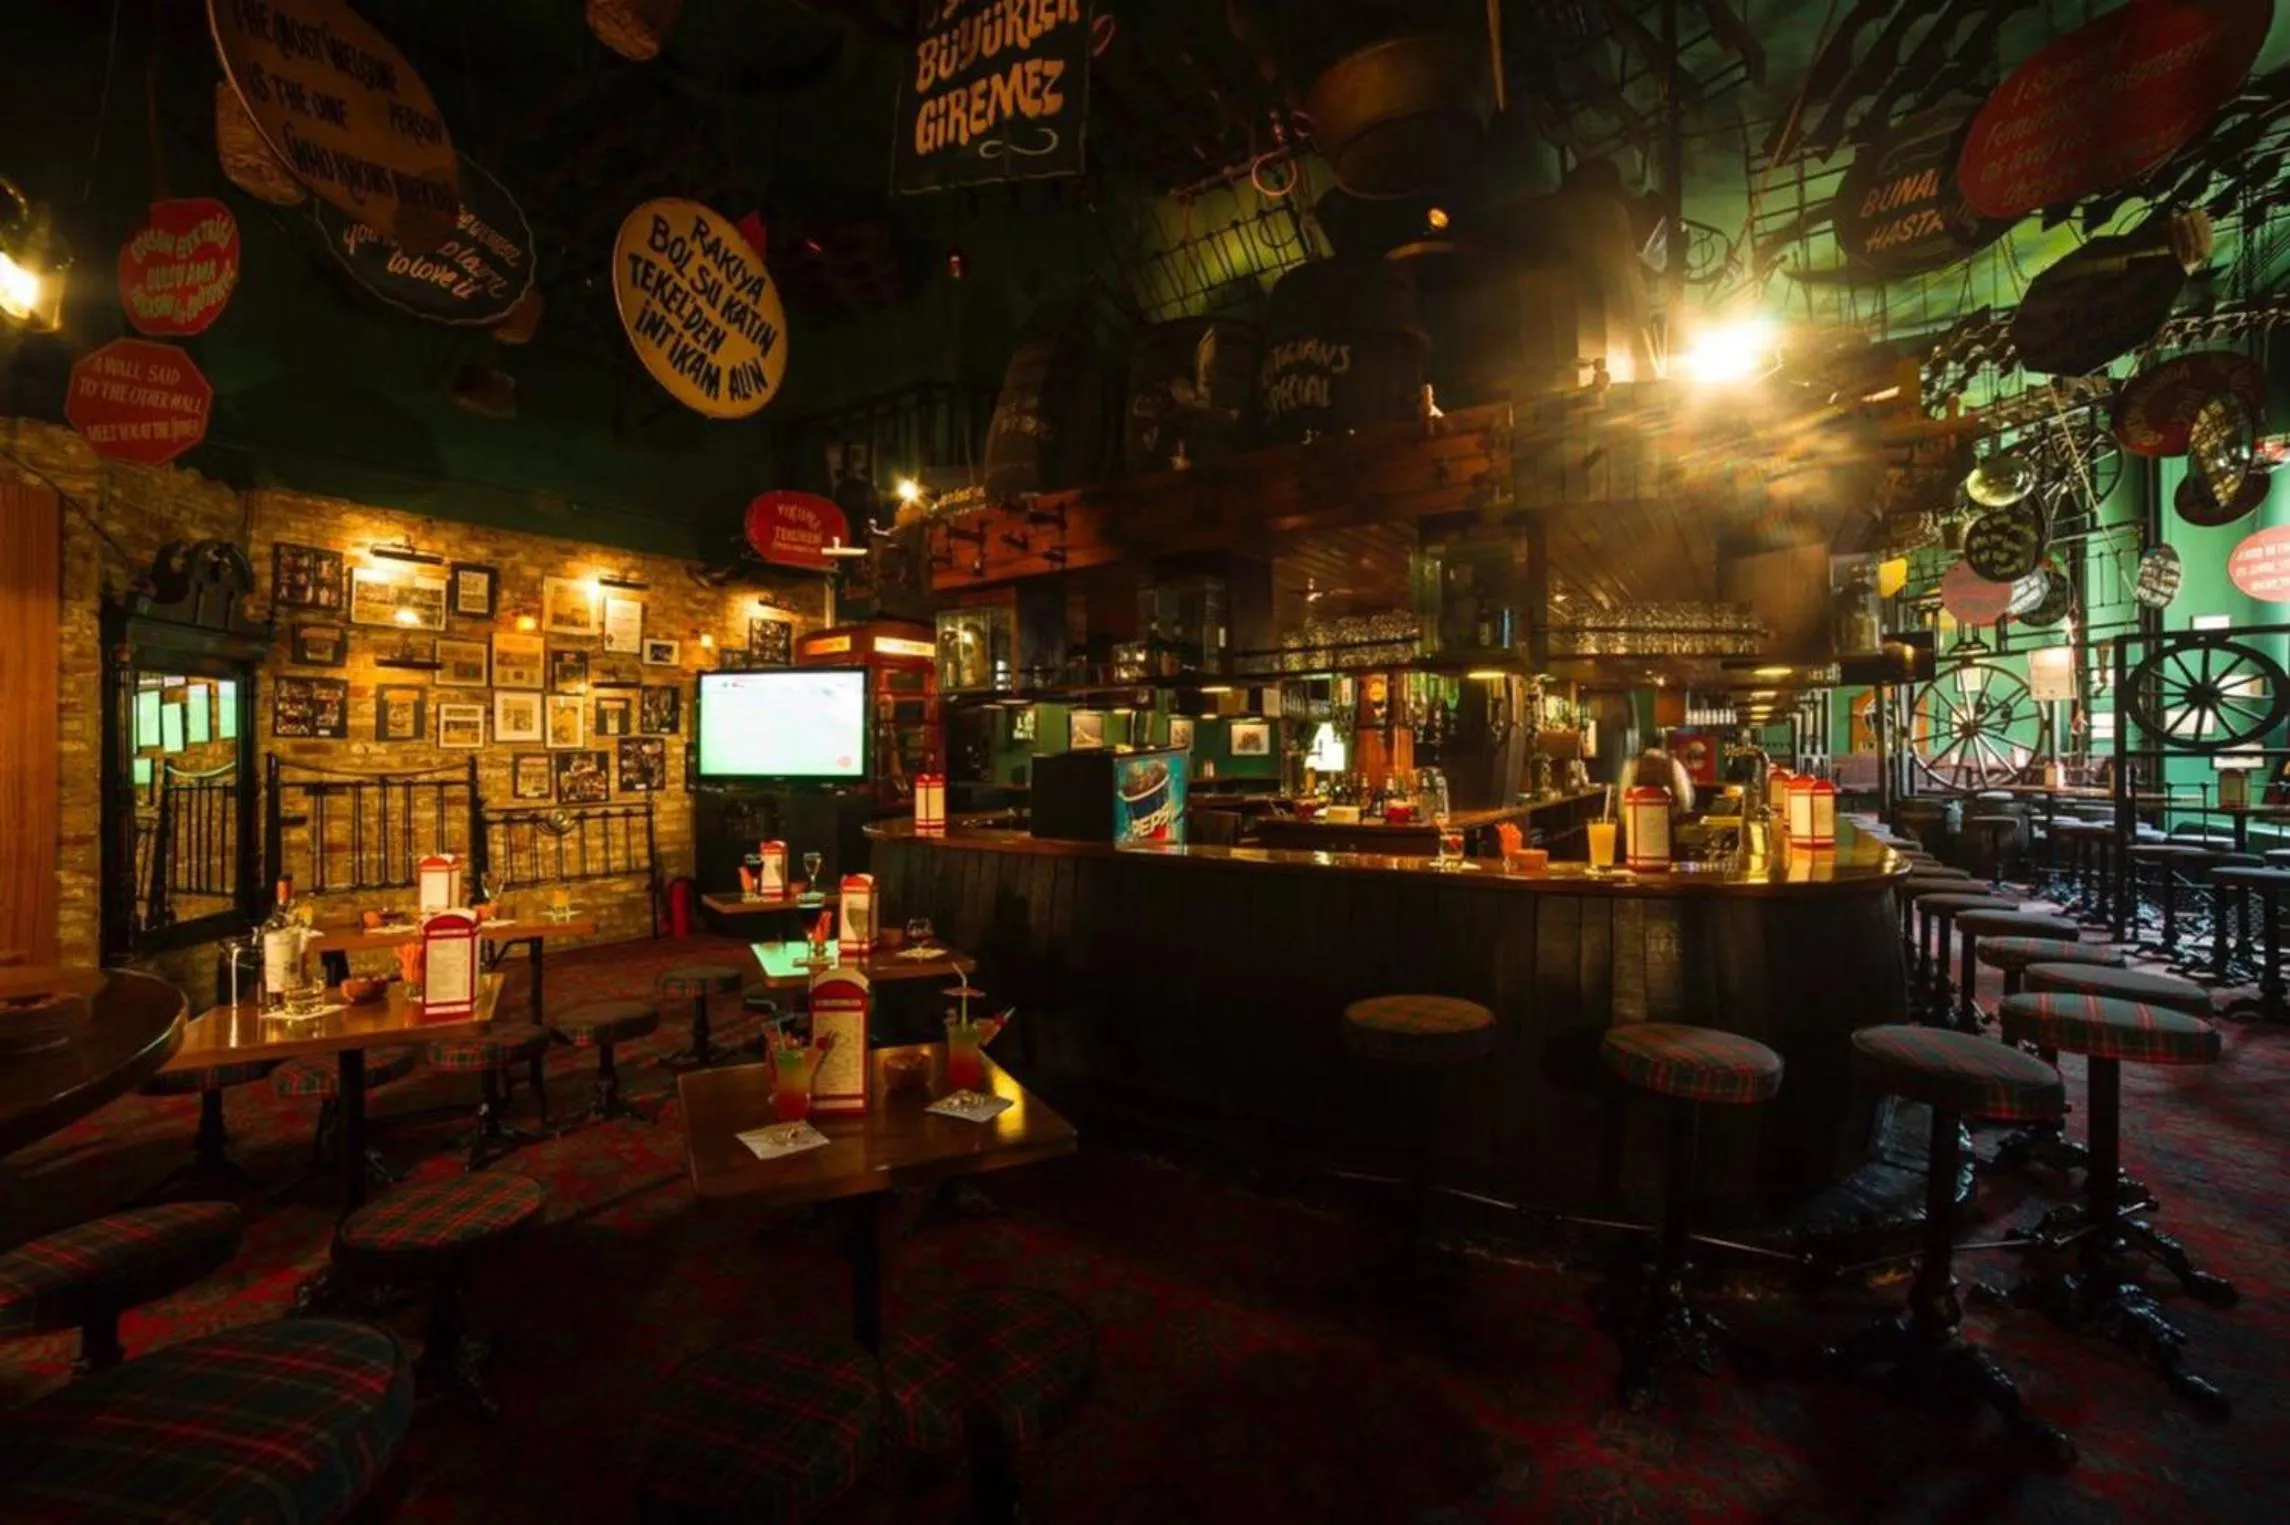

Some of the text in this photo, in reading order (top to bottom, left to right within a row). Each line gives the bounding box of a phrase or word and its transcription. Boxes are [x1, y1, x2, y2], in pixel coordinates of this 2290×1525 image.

[408, 256, 460, 288] love
[690, 214, 766, 305] RAKIYA
[649, 213, 778, 359] BOL SU KATIN
[104, 356, 140, 381] WALL
[148, 364, 181, 386] SAID
[728, 358, 769, 401] ALIN
[79, 377, 203, 417] TO THE OTHER WALL
